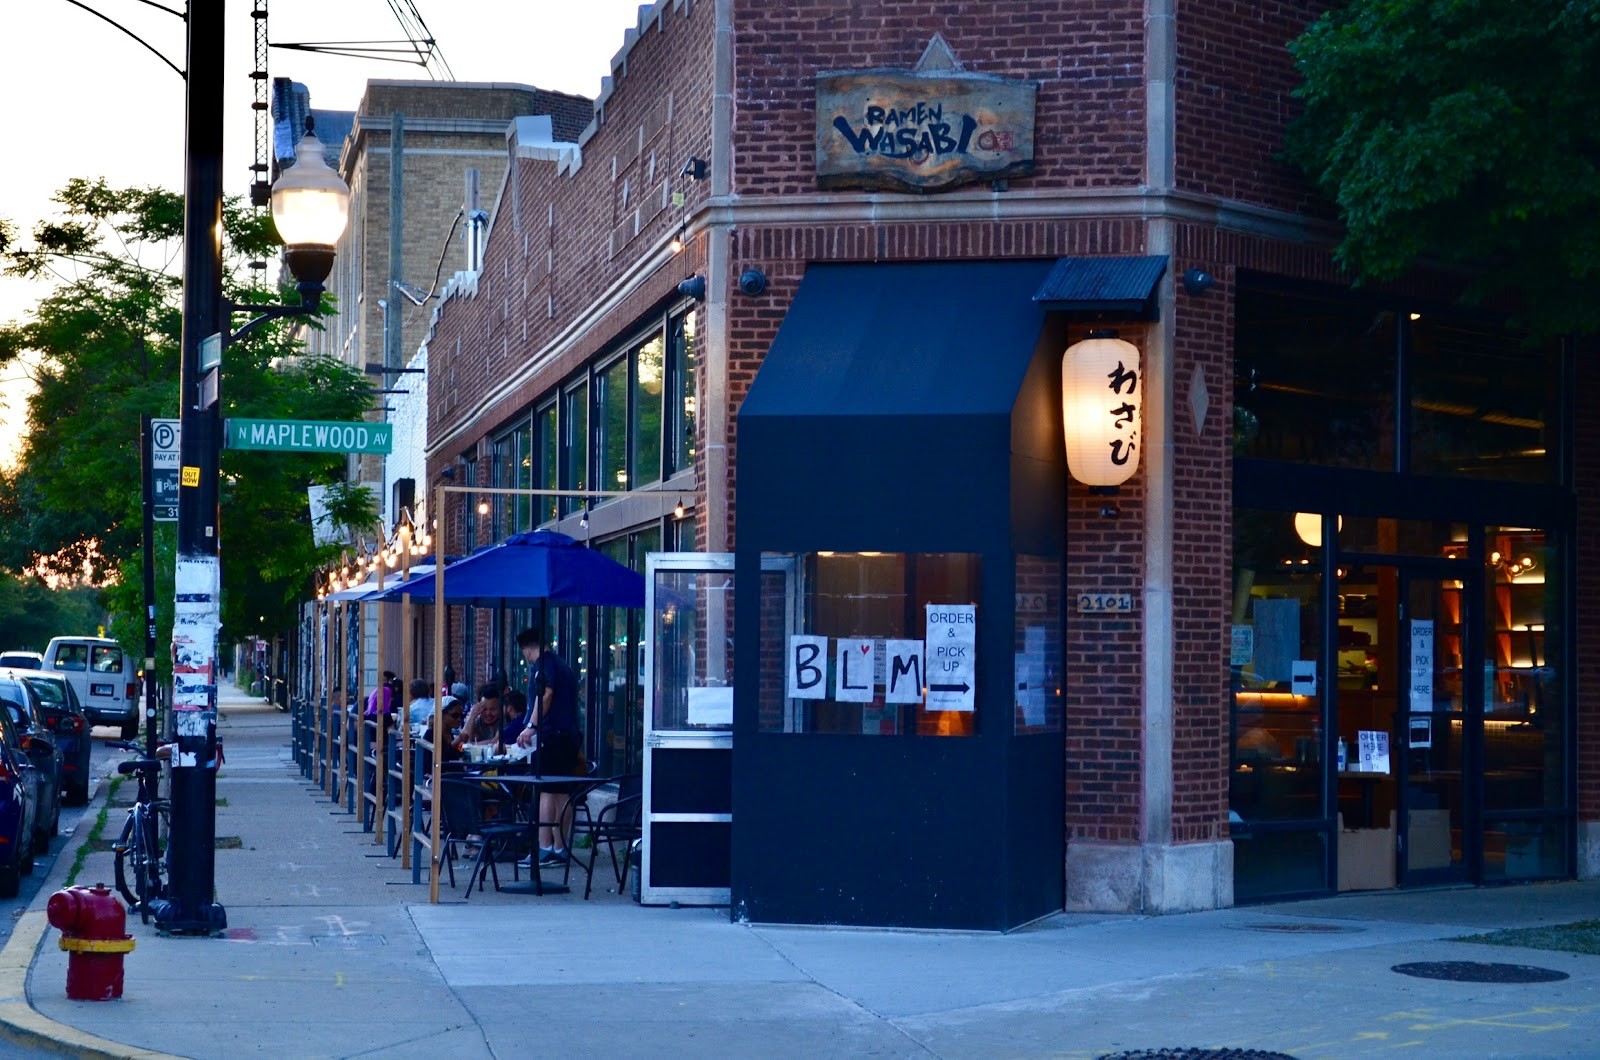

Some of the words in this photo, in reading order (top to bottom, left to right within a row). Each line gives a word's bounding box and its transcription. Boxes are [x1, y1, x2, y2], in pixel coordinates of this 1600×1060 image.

[867, 102, 942, 126] RAMEN
[833, 114, 977, 158] WASABI
[1108, 361, 1137, 465] わさび
[239, 427, 247, 440] N
[251, 423, 368, 449] MAPLEWOOD
[373, 433, 387, 445] AV
[1081, 596, 1129, 610] 2101
[930, 612, 974, 624] ORDER
[948, 627, 956, 638] &
[1412, 627, 1433, 636] ORDER
[937, 646, 966, 657] PICK
[942, 661, 959, 671] UP
[1415, 656, 1429, 665] PICK
[1418, 668, 1426, 677] UP
[1414, 685, 1430, 694] HERE
[1360, 733, 1387, 741] ORDER
